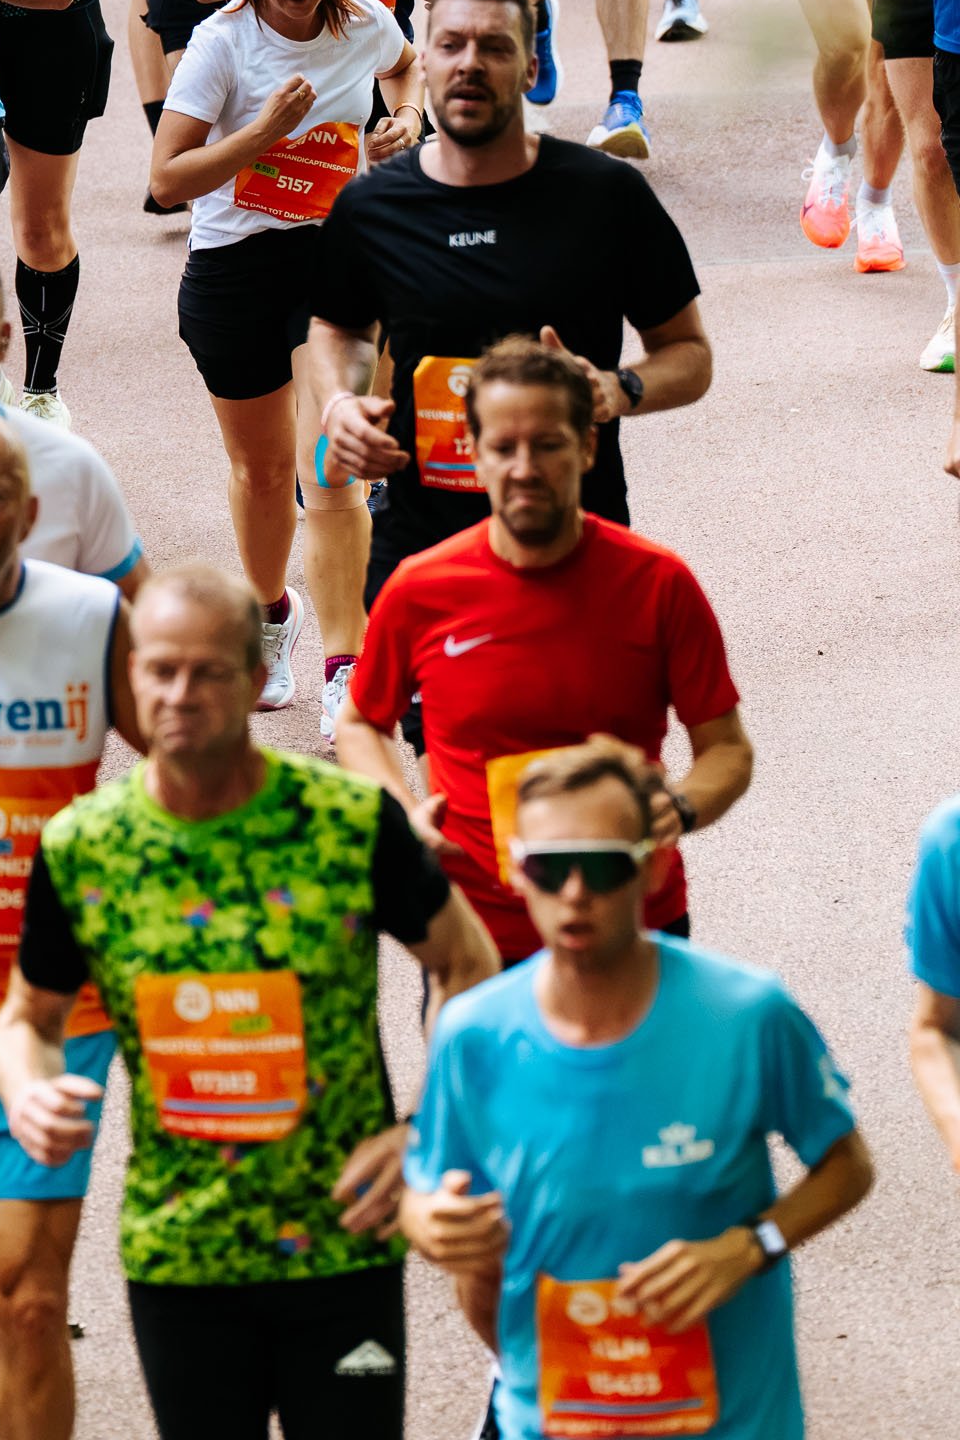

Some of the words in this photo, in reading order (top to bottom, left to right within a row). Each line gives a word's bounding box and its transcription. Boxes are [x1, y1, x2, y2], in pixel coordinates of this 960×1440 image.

[308, 130, 338, 145] NN
[276, 174, 314, 194] 5157
[250, 202, 268, 212] DAM
[268, 207, 283, 216] TOT
[283, 210, 311, 221] DAML
[448, 229, 497, 248] KEUNE
